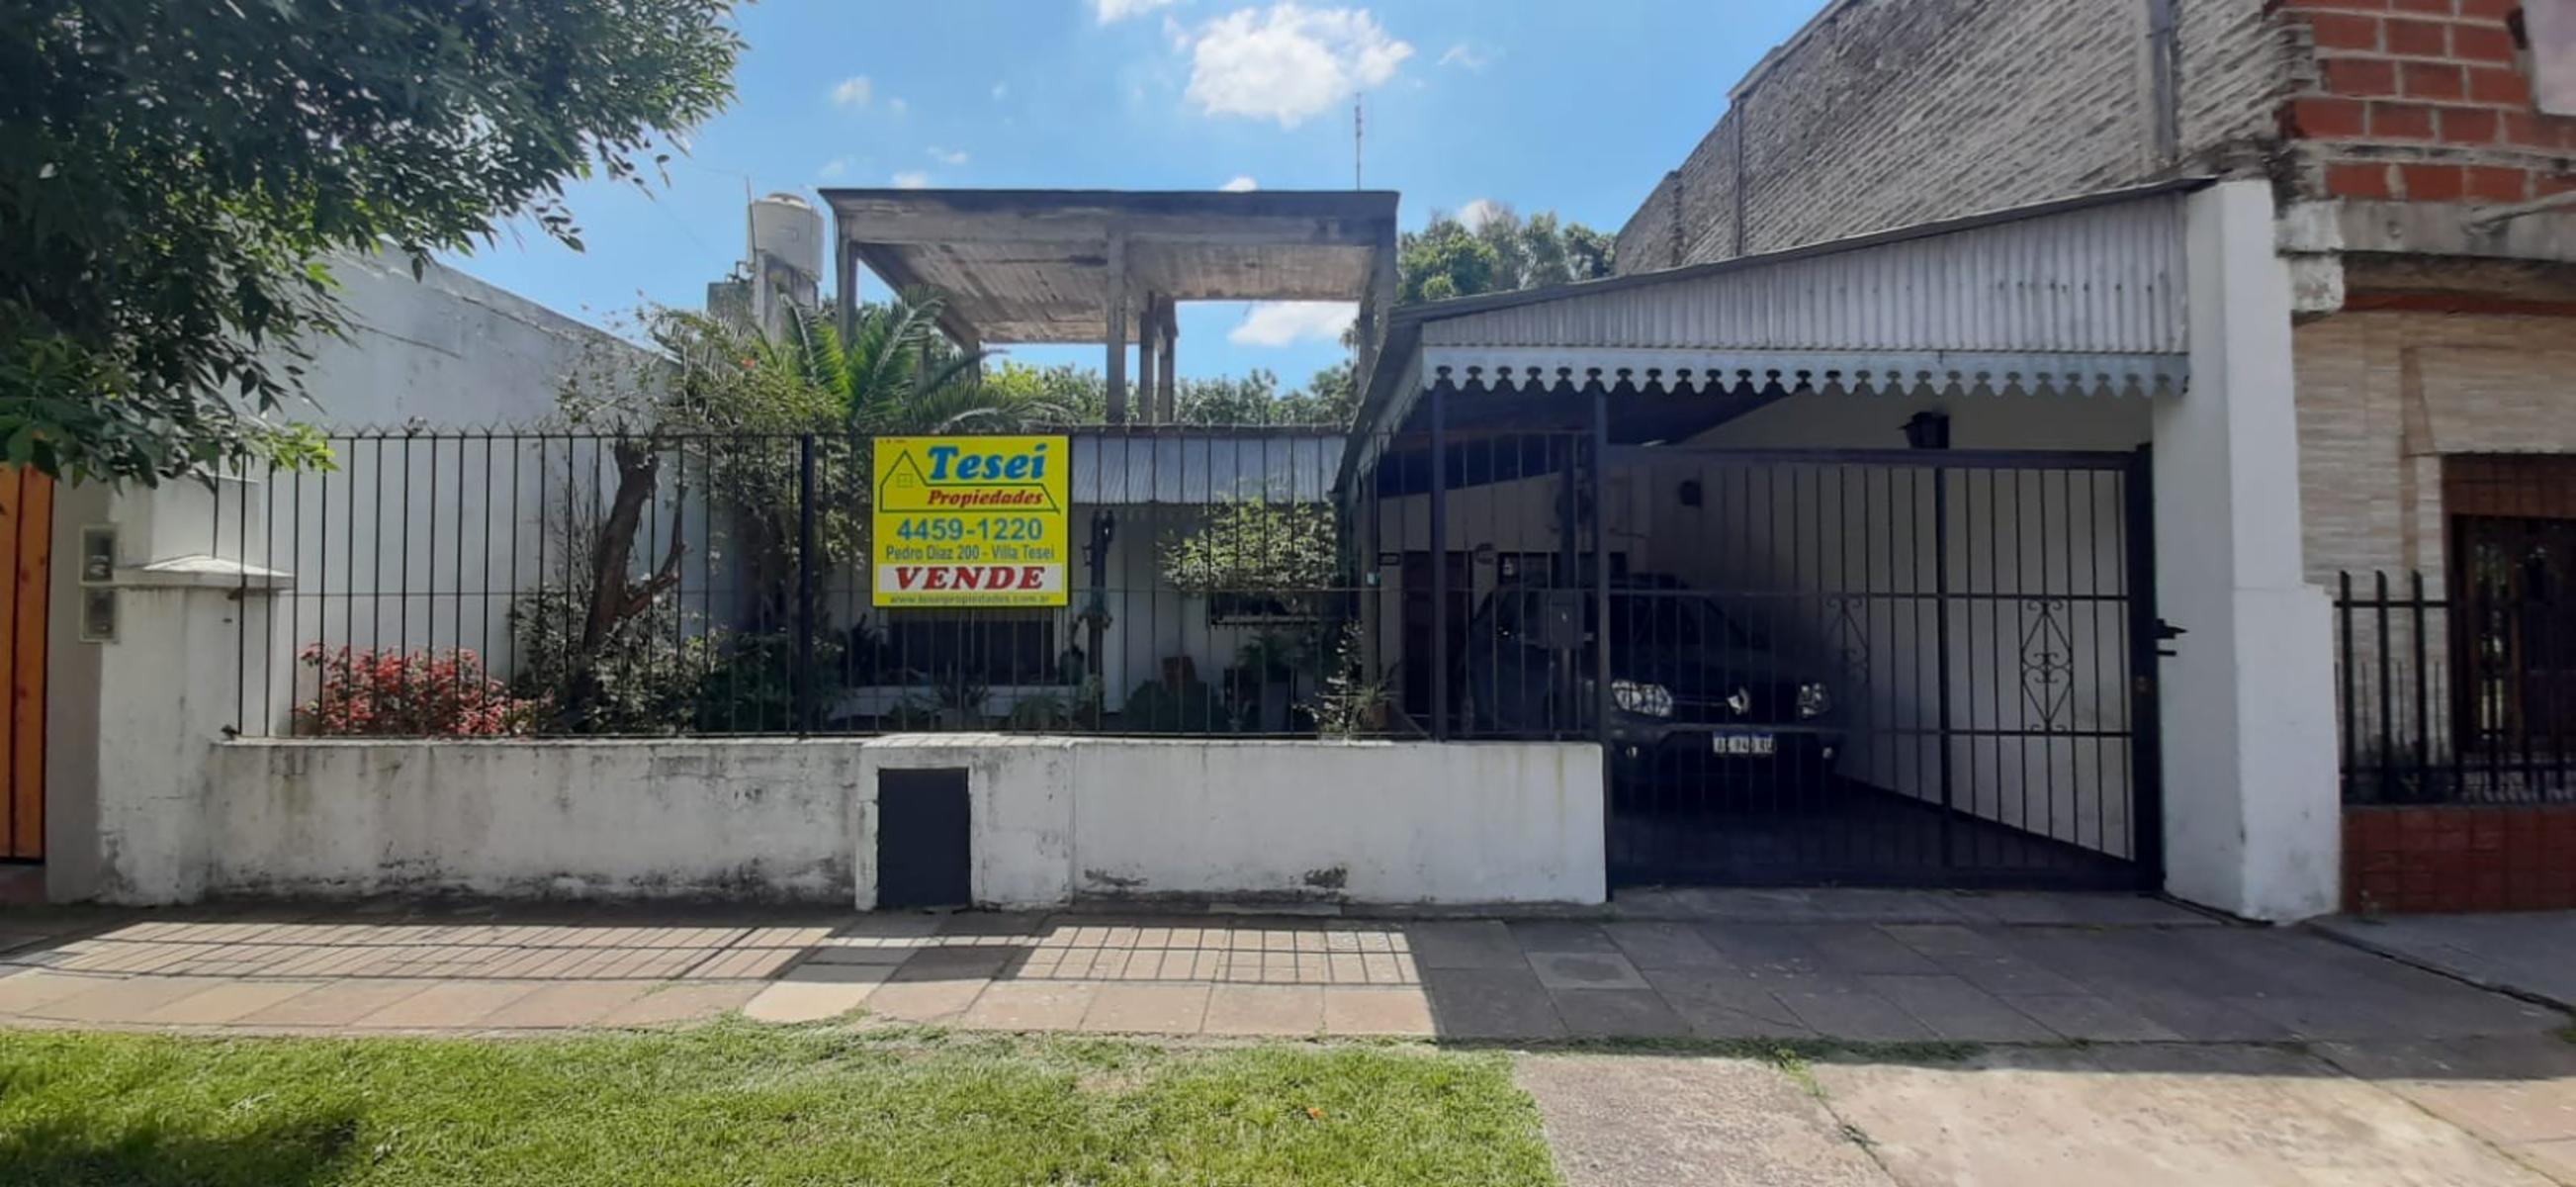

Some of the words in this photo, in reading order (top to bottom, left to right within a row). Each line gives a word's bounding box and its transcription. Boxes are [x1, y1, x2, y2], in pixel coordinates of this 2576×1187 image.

[927, 443, 1048, 480] Tesei
[927, 490, 1043, 508] Propiedades
[897, 518, 1043, 540] 4459-1220
[886, 545, 922, 560] Pedro
[958, 545, 980, 560] 200
[992, 545, 1018, 560] Villa
[1023, 545, 1055, 560] Tesei
[895, 567, 1046, 590] VENDE
